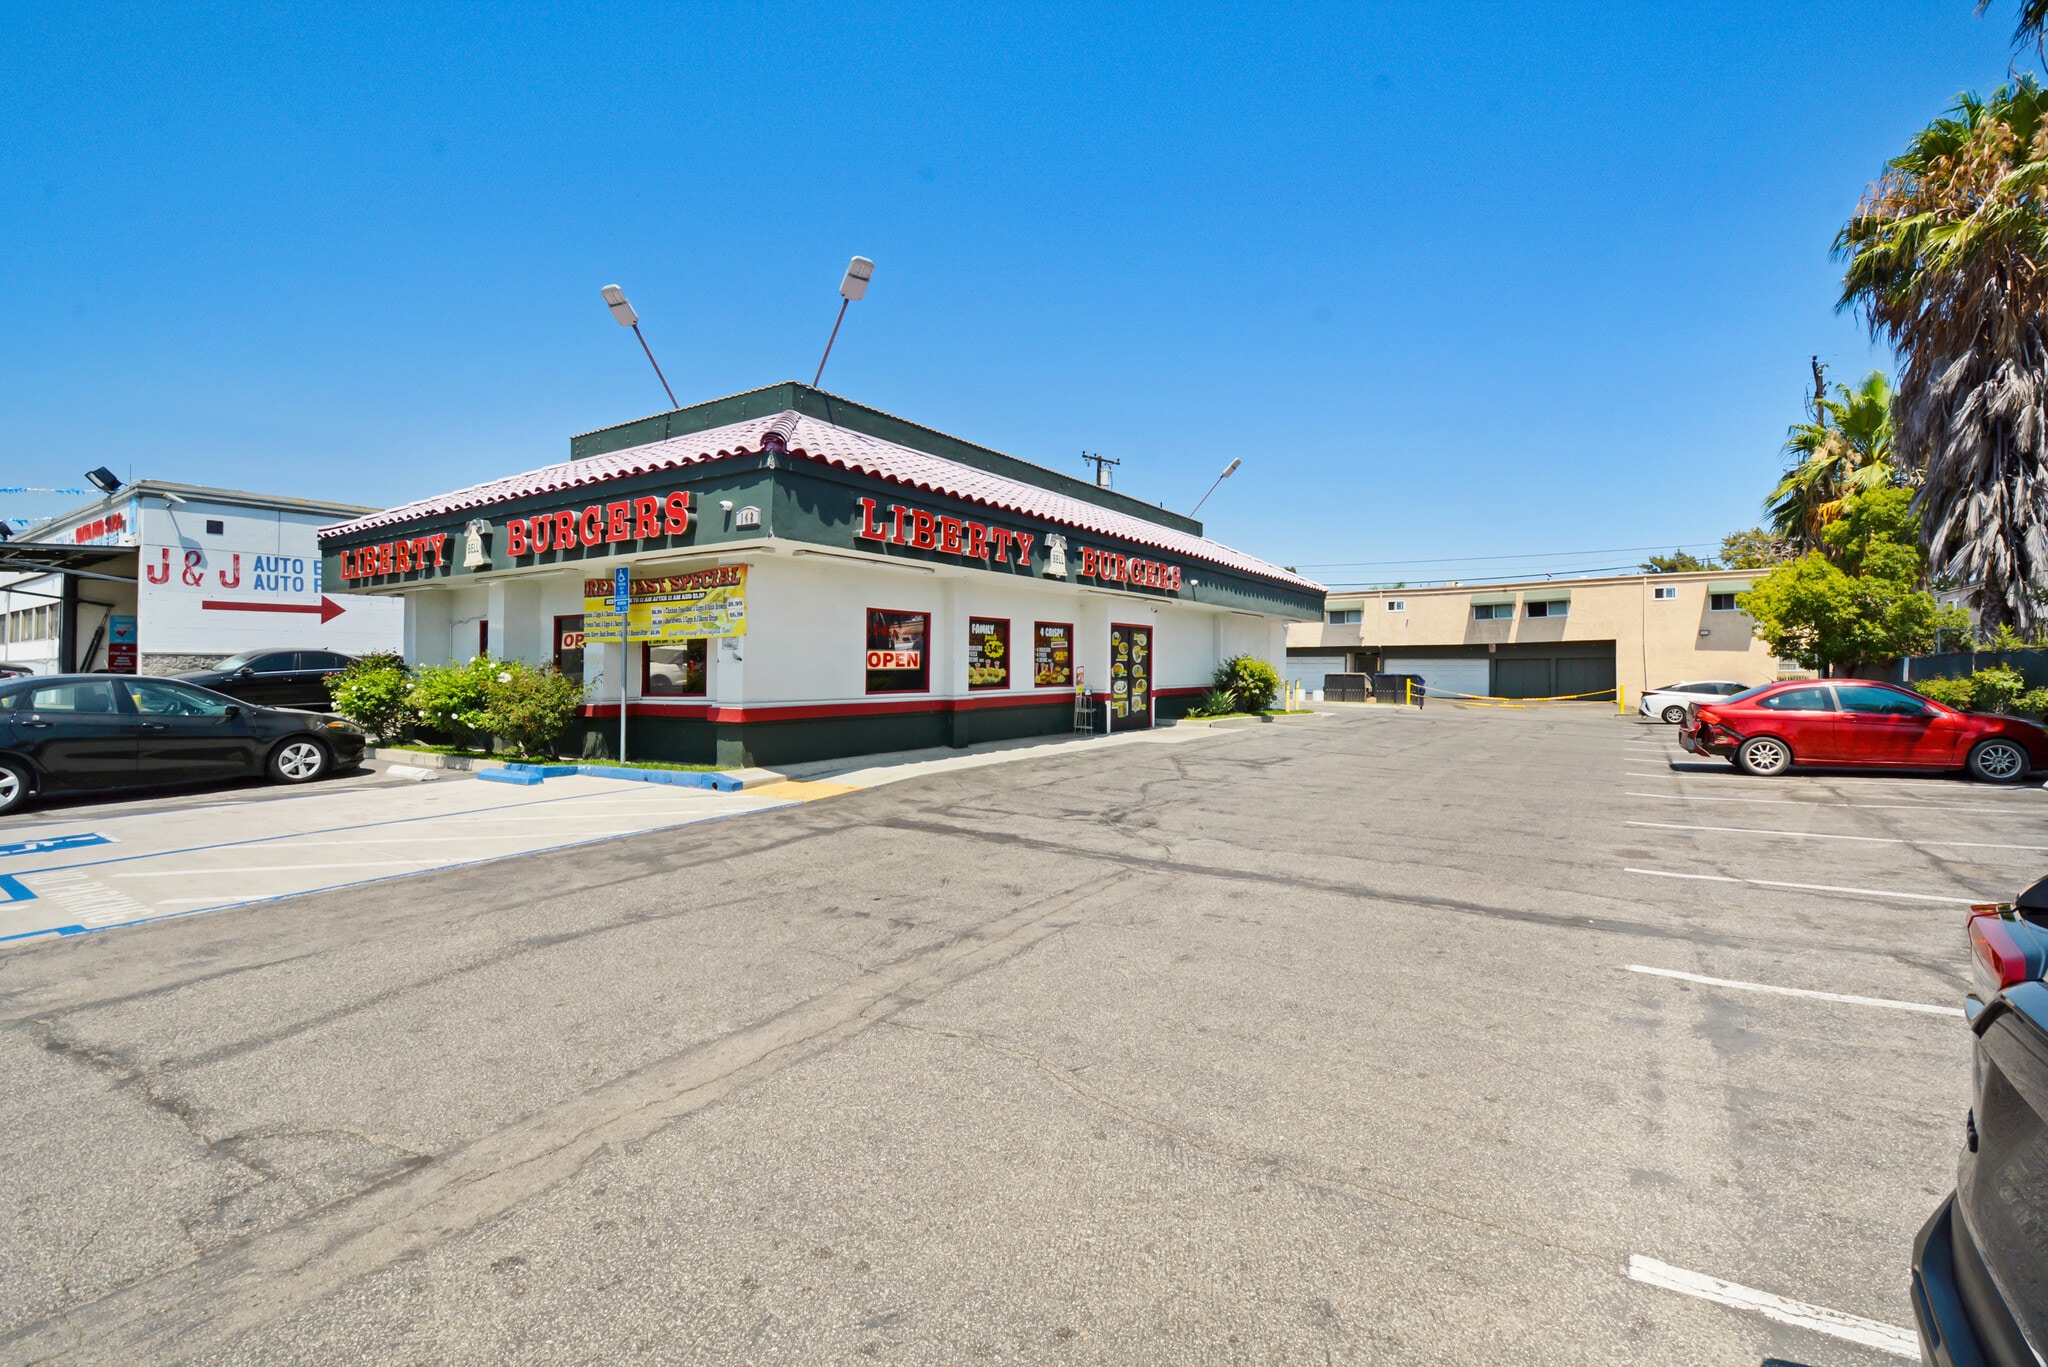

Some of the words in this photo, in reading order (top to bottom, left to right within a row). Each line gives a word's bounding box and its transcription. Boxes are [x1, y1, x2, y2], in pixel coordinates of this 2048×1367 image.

[340, 532, 448, 581] LIBERTY
[506, 490, 691, 557] BURGERS
[859, 496, 1034, 567] LIBERTY
[1081, 546, 1182, 592] BURGERS
[467, 543, 479, 554] BELL
[147, 548, 170, 585] J
[181, 550, 205, 587] &
[219, 553, 241, 589] J
[253, 555, 304, 575] AUTO
[1052, 554, 1064, 565] BELL
[253, 574, 304, 593] AUTO
[584, 577, 666, 599] REAAST
[669, 566, 741, 592] SPECIAL
[972, 623, 995, 635] FAMILY
[563, 633, 584, 647] OP
[867, 652, 919, 668] OPEN
